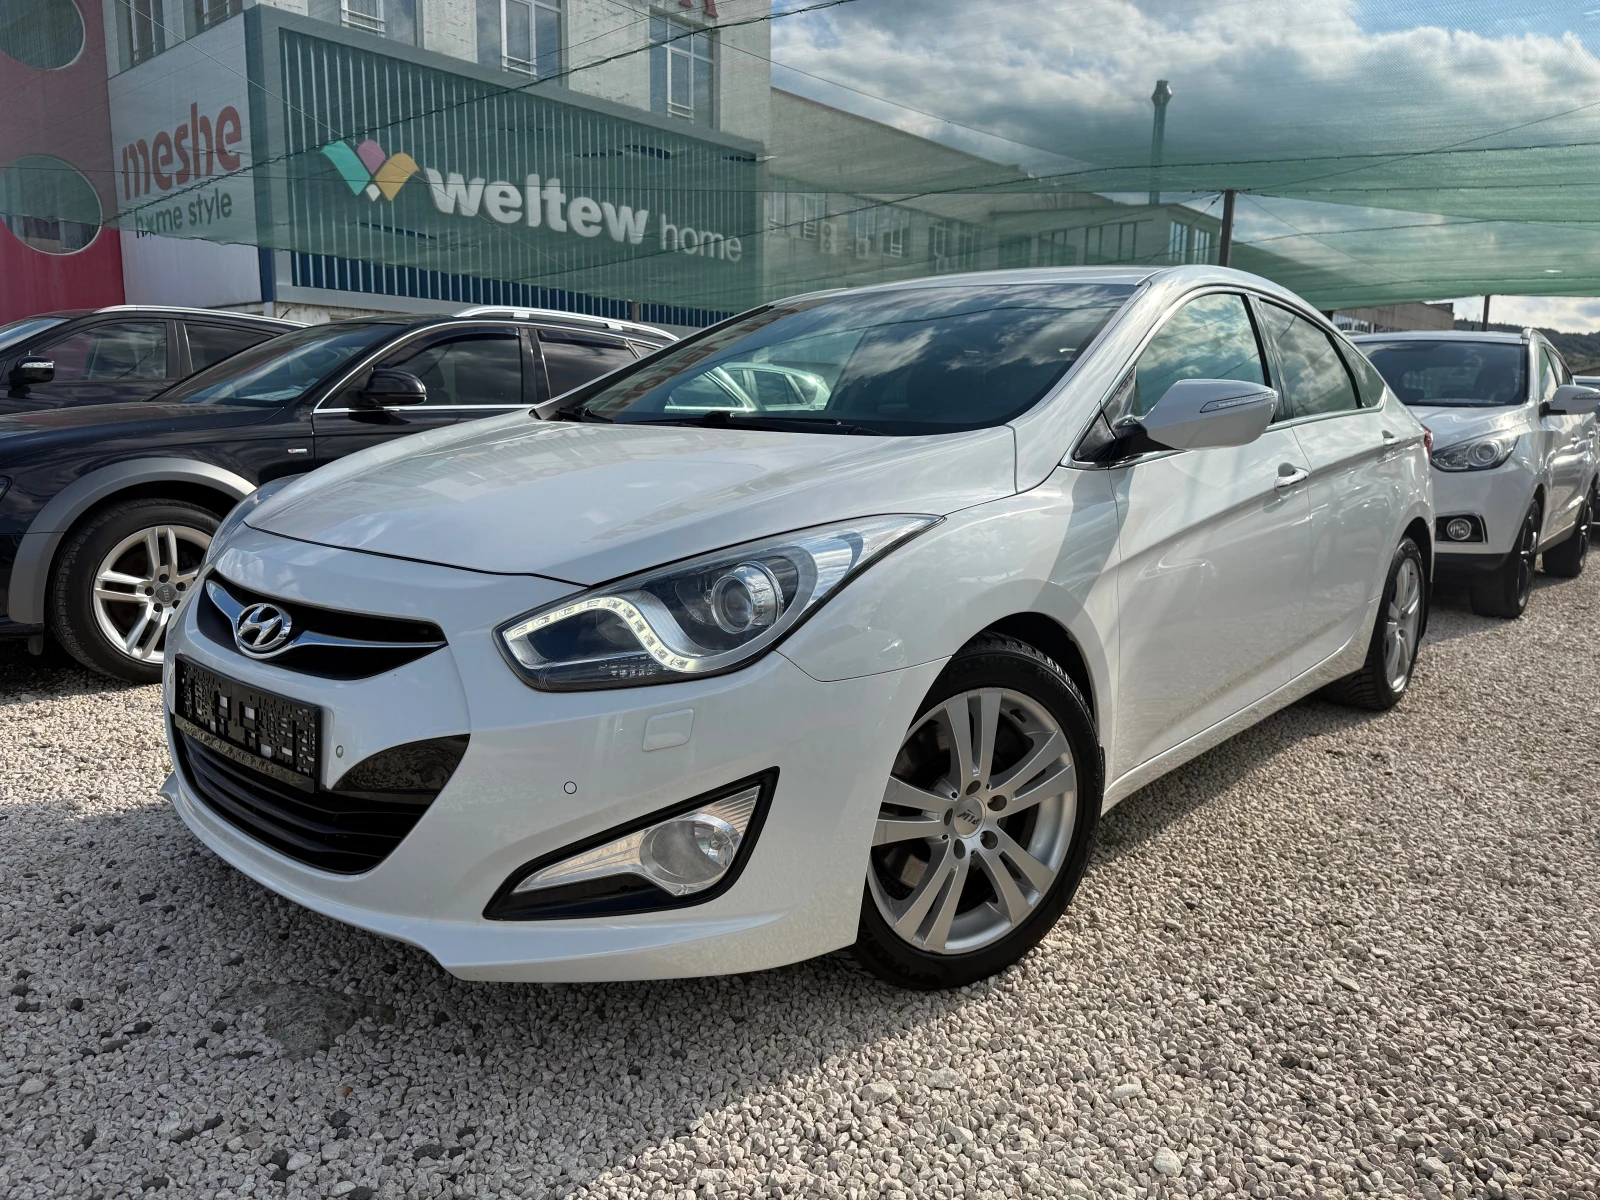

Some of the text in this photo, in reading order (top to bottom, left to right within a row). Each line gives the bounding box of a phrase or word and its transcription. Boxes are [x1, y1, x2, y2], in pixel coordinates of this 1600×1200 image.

[121, 101, 243, 201] meshe
[187, 187, 233, 226] style
[424, 167, 743, 262] weltew home
